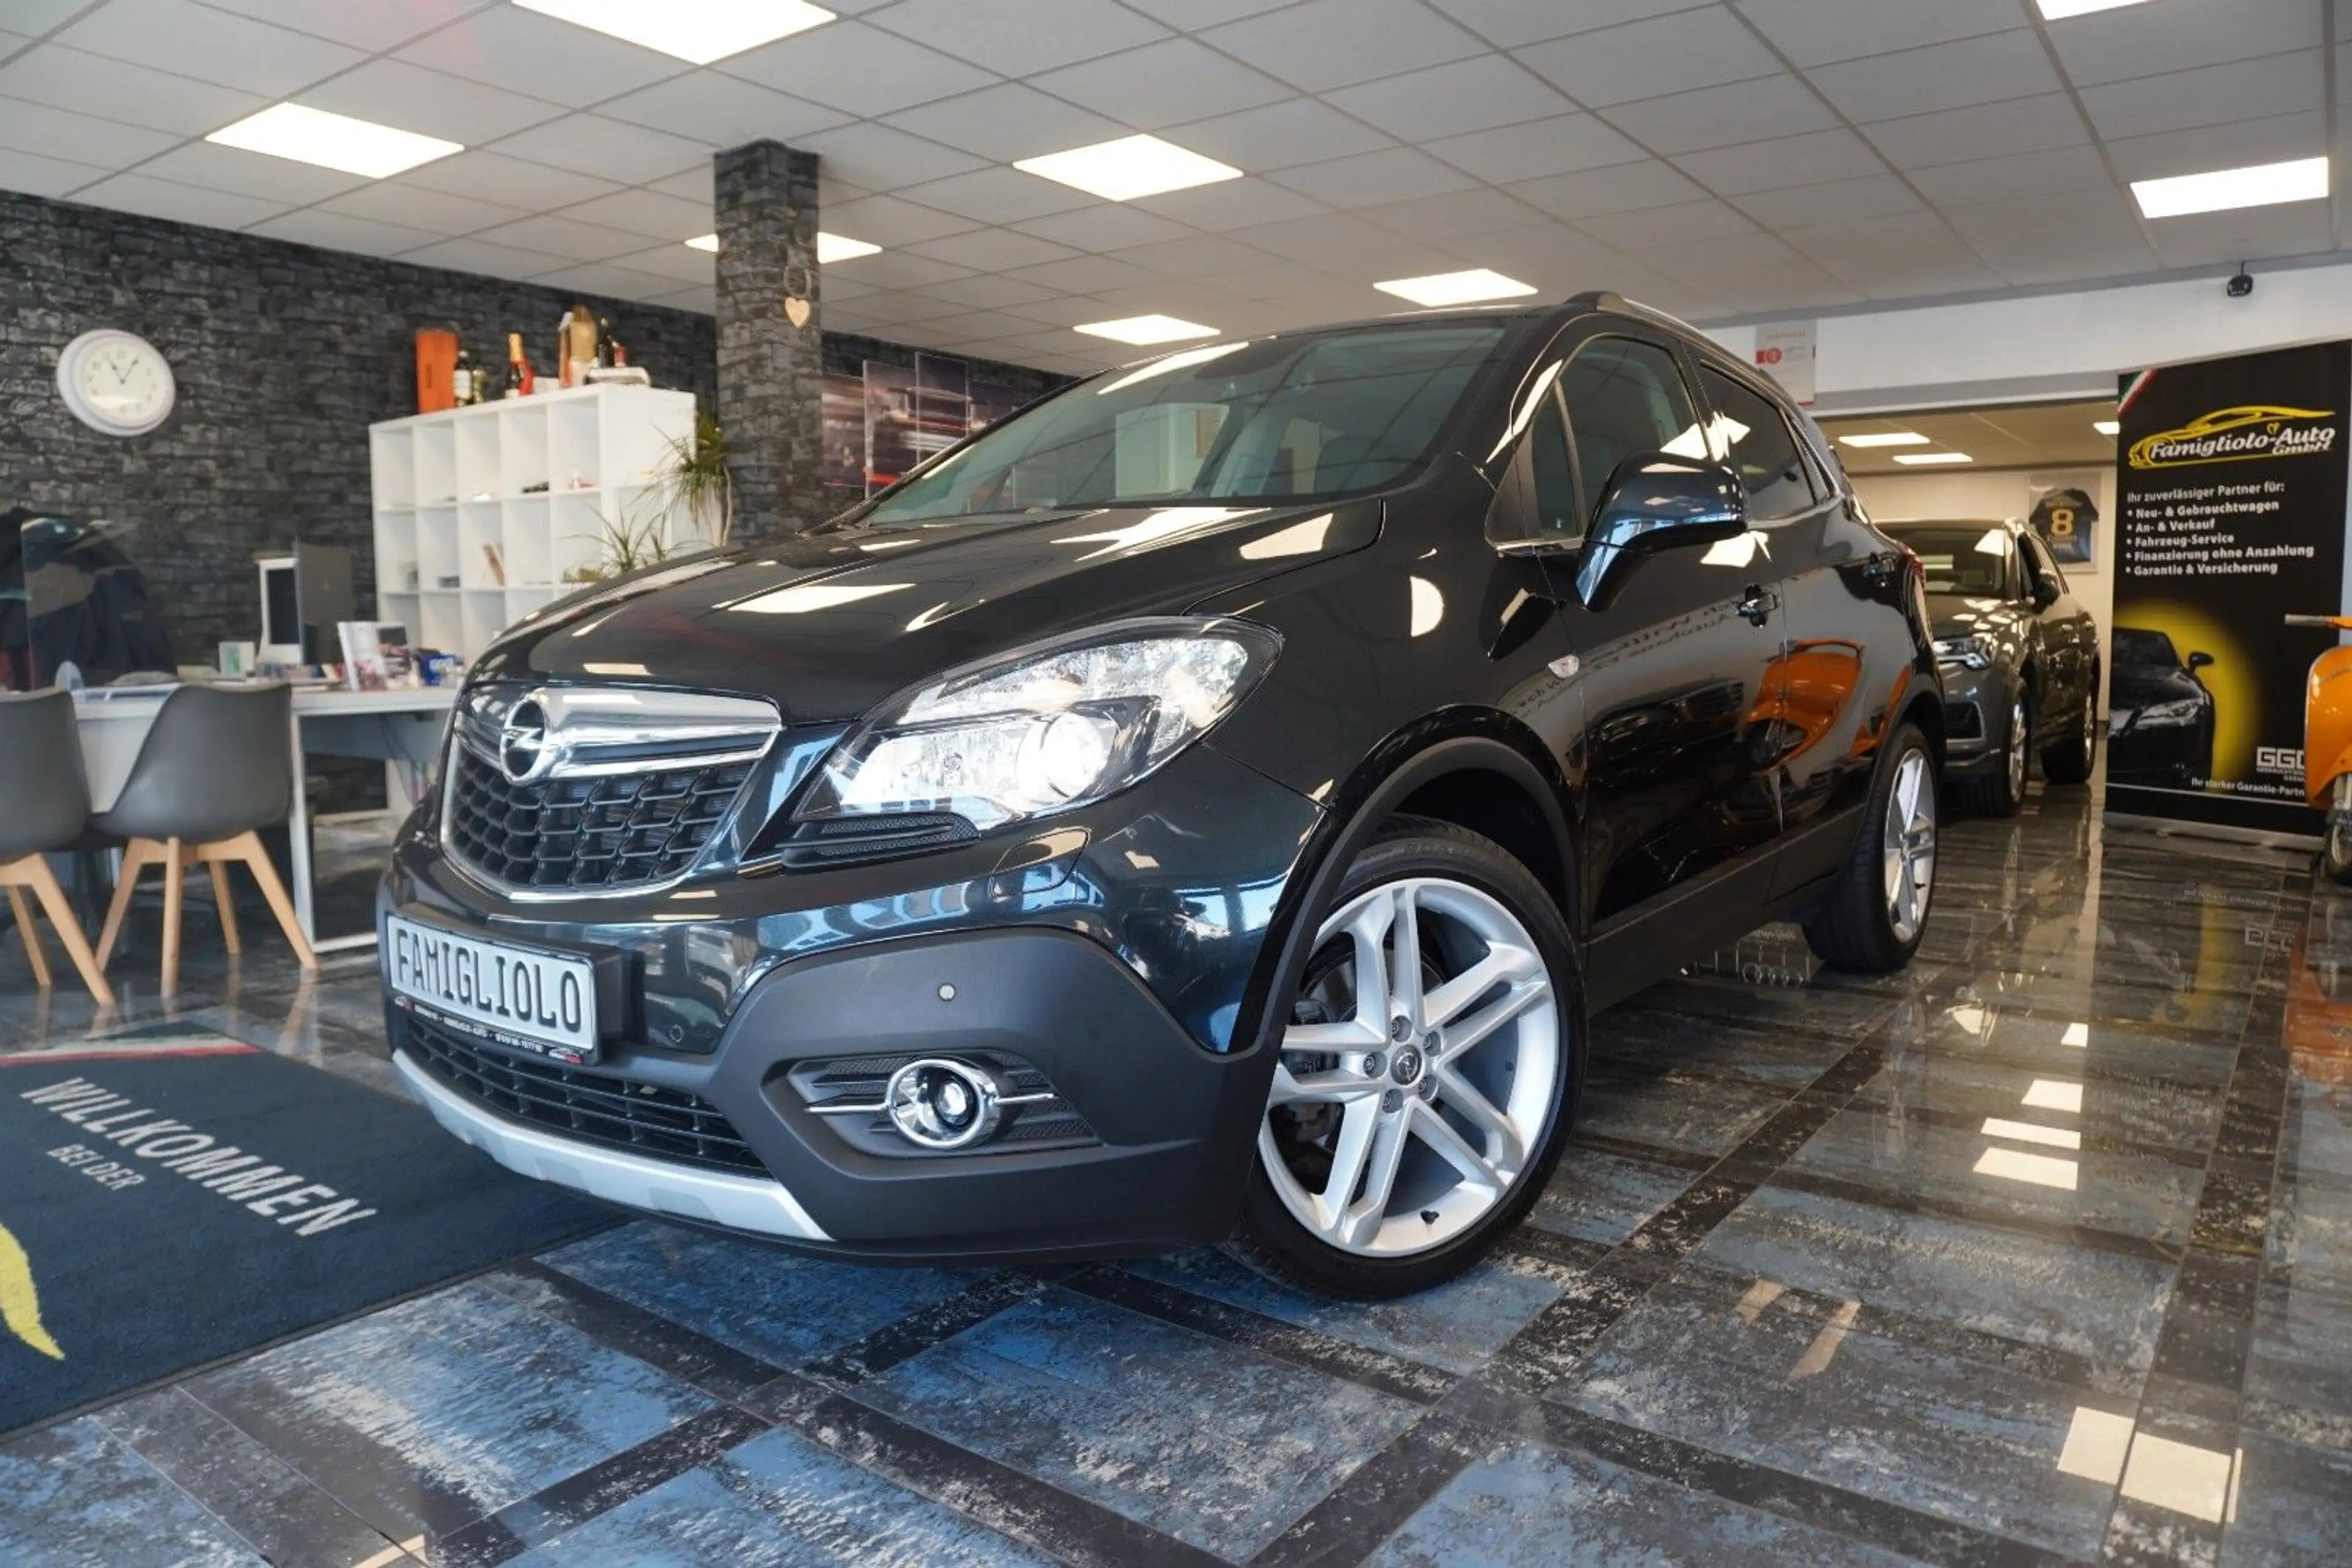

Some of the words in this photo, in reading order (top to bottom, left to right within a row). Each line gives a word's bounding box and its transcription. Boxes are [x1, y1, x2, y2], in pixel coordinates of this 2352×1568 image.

[2150, 426, 2335, 459] Famigliolo-Auto
[2127, 491, 2142, 503] Ihr
[2144, 488, 2215, 502] zuverlässiger
[2218, 484, 2261, 496] Partner
[2264, 480, 2285, 493] für:
[2135, 508, 2163, 519] Neu-
[2165, 505, 2174, 517] &
[2177, 501, 2280, 516] Gebrauchtwagen
[2051, 508, 2074, 537] 8
[2135, 522, 2155, 533] An-
[2157, 521, 2166, 532] &
[2169, 518, 2215, 532] Verkauf
[2135, 532, 2235, 548] Fahrzeug-Service
[2134, 549, 2209, 562] Finanzierung
[2212, 546, 2243, 559] ohne
[2245, 544, 2315, 558] Anzahlung
[2134, 564, 2184, 576] Garantie
[2185, 563, 2194, 575] &
[2196, 561, 2278, 575] Versicherung
[2192, 776, 2204, 787] Ihr
[2205, 778, 2236, 790] starker
[2237, 782, 2305, 797] Garantie-Partn
[396, 929, 582, 1033] FAMIGLIOLO
[20, 1077, 378, 1236] WILLKOMMEN
[46, 1144, 105, 1167] BEI
[80, 1161, 147, 1191] DER
